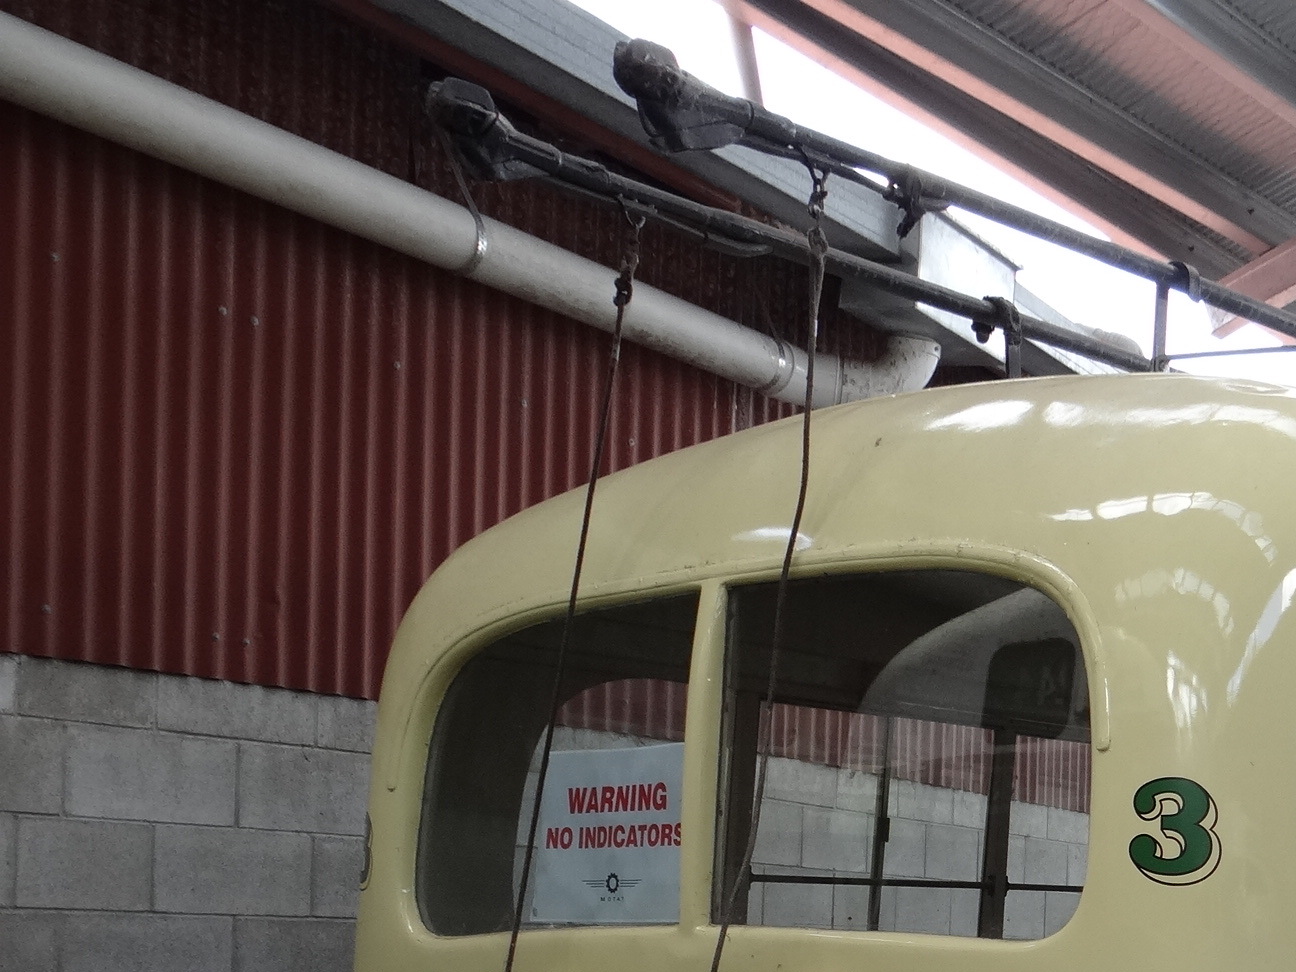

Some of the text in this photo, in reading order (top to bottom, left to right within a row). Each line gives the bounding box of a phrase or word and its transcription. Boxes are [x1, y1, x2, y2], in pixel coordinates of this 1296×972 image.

[567, 782, 668, 815] WARNING
[545, 822, 682, 850] NO INDICATORS
[1129, 776, 1222, 886] 3
